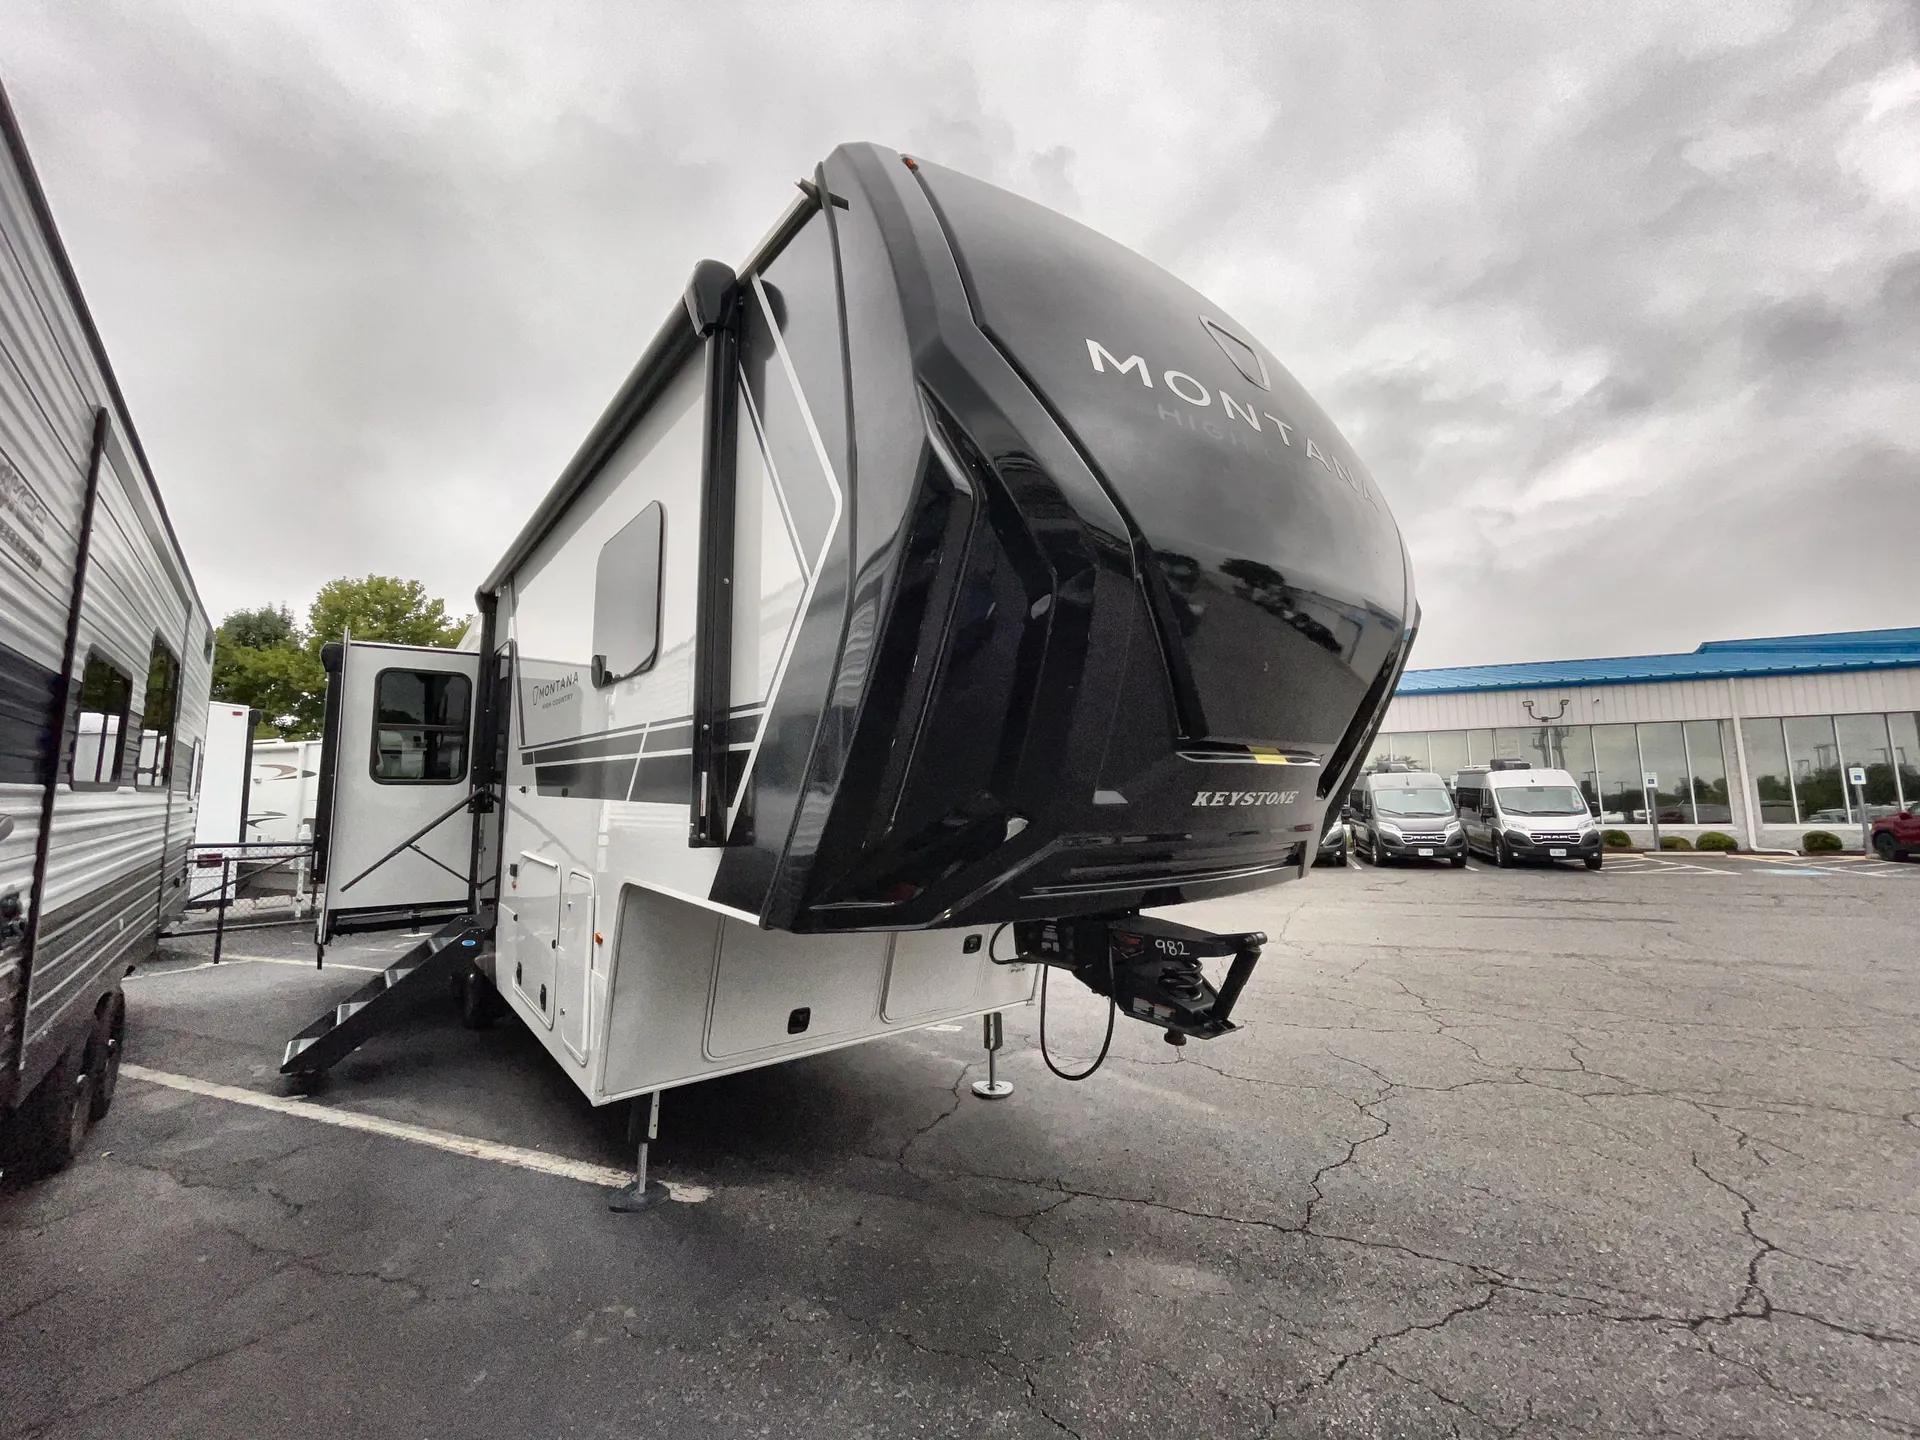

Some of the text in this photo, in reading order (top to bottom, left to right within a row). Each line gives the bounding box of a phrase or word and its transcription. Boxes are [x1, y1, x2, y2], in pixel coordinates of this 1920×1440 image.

[1085, 338, 1380, 513] MONTANA
[1156, 403, 1249, 453] HIGH
[539, 672, 579, 699] MONTANA
[1191, 790, 1299, 807] KEYSTONE
[1154, 939, 1191, 956] 982
